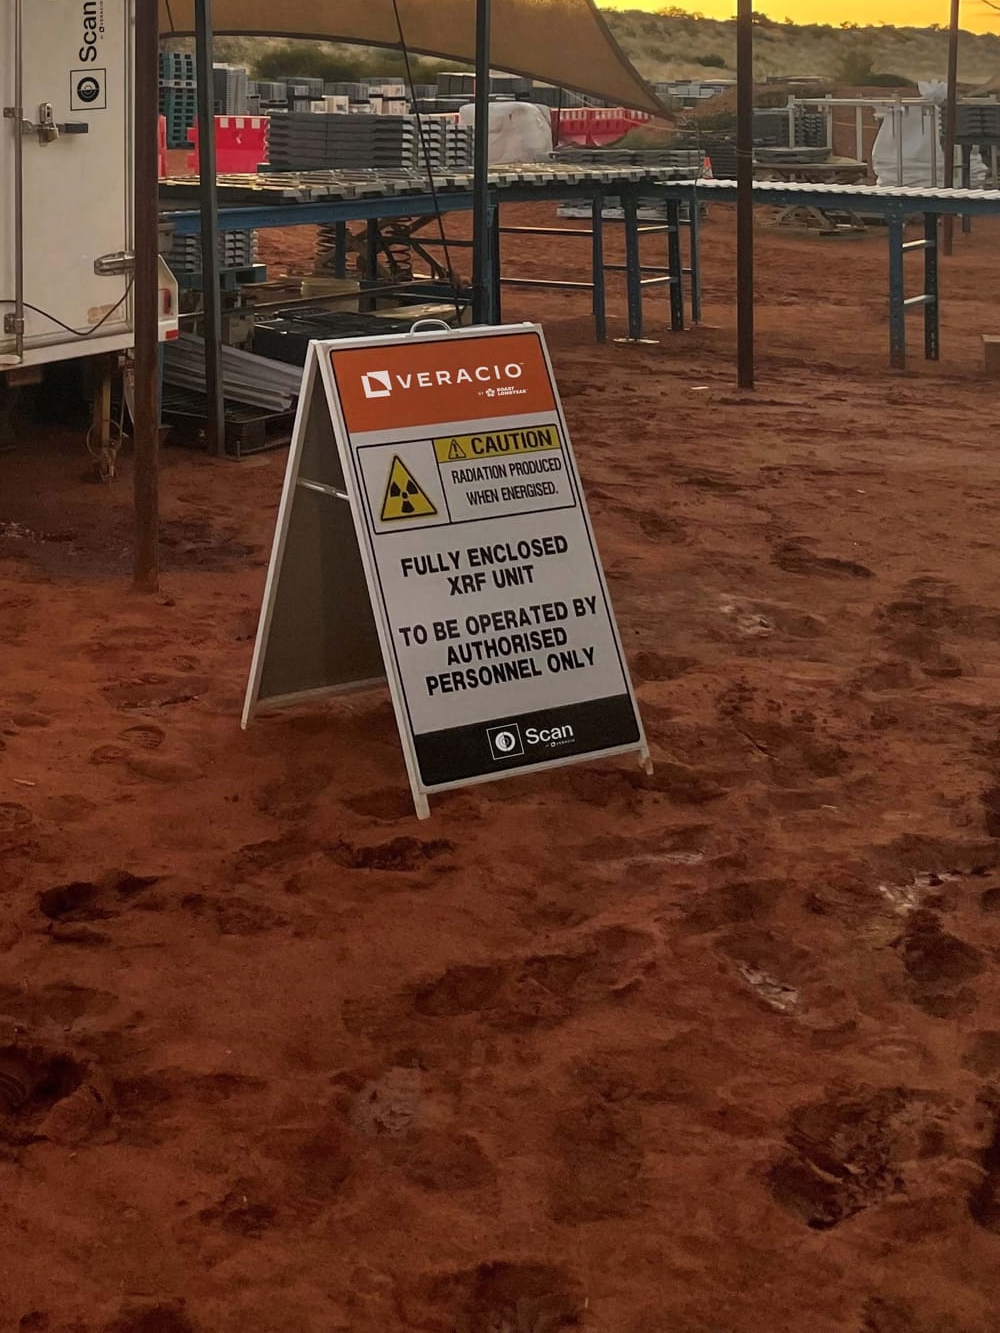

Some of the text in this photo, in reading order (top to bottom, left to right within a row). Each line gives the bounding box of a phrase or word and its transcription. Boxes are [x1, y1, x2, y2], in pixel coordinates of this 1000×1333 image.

[79, 1, 97, 62] Scan
[396, 363, 522, 389] VERACIO
[471, 429, 552, 454] CAUTION
[451, 457, 561, 484] RADIATION PRODUCED
[466, 482, 559, 506] WHEN ENERGISED.
[400, 535, 568, 577] FULLY ENCLOSED
[447, 565, 534, 595] XRF UNIT
[399, 596, 596, 646] TO BE OPERATED BY
[447, 627, 568, 666] AUTHORISED
[425, 647, 595, 696] PERSONNEL ONLY
[525, 725, 574, 745] Scan
